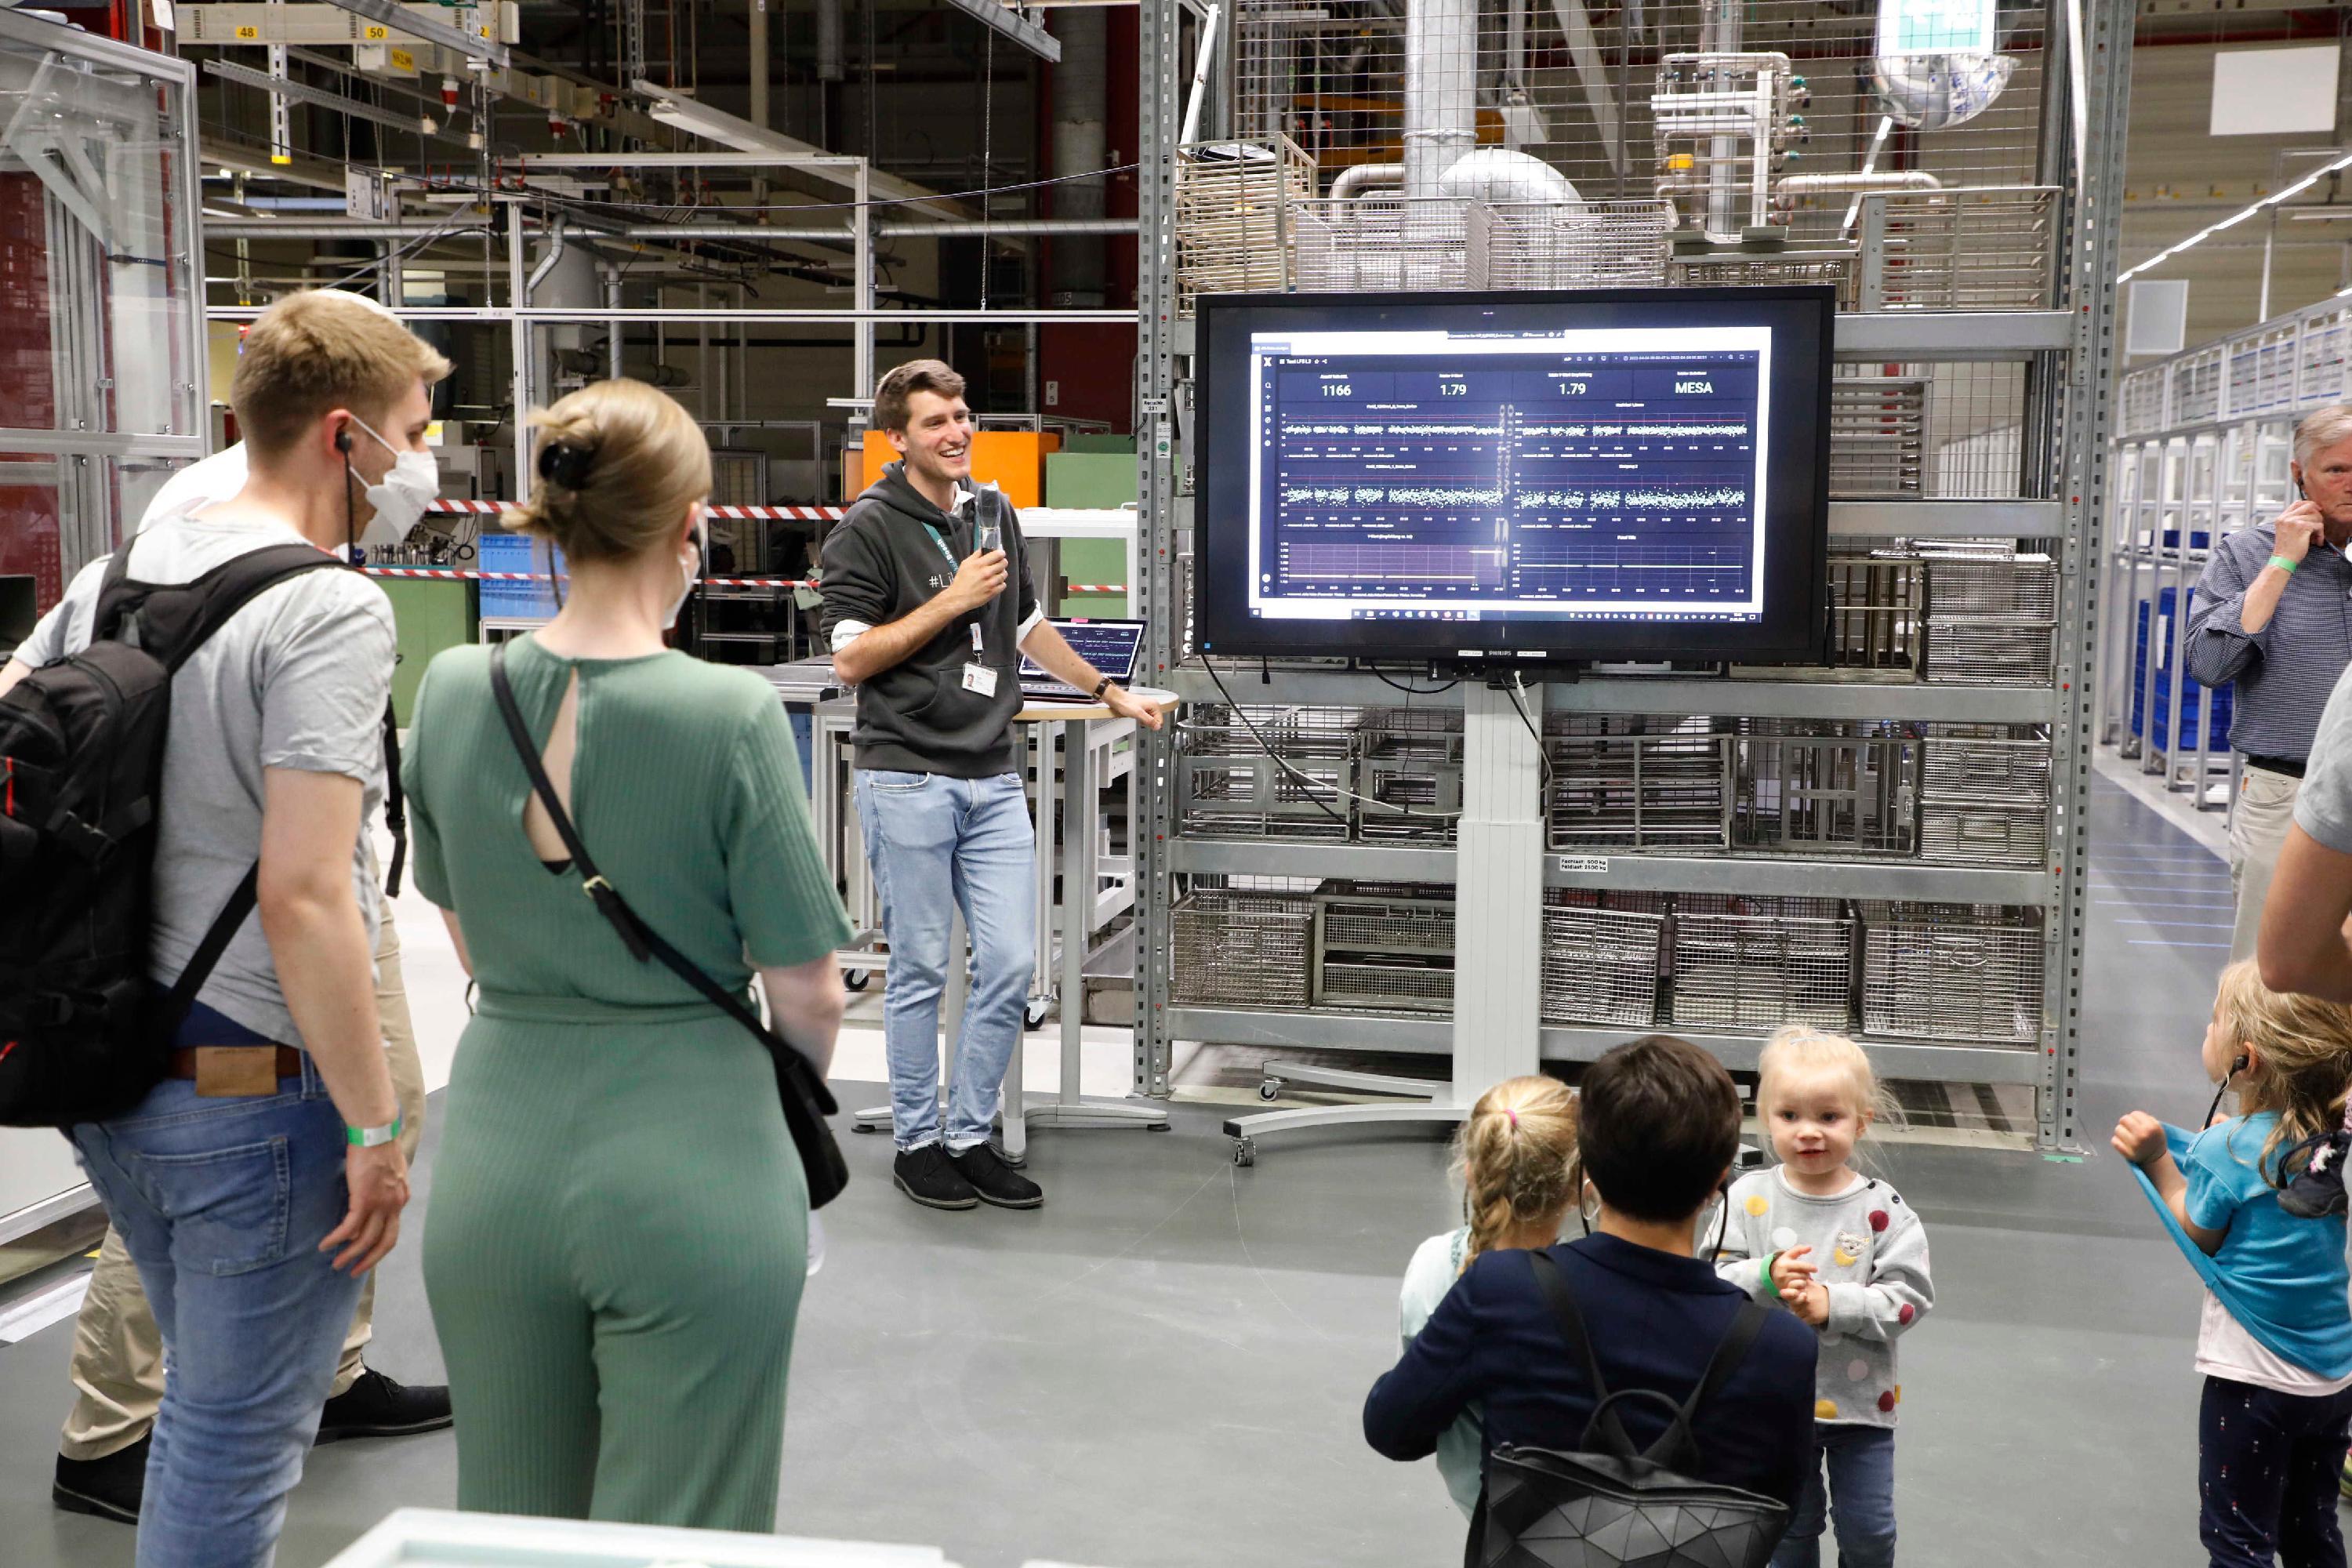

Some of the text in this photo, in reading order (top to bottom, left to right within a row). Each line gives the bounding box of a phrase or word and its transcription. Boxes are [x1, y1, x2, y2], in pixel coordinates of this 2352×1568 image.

[240, 27, 254, 37] 48
[369, 27, 384, 37] 50
[1321, 384, 1352, 396] 1166
[1439, 384, 1467, 395] 1.79
[1559, 383, 1587, 394] 1.79
[1675, 382, 1713, 394] MESA
[928, 572, 954, 588] #Li
